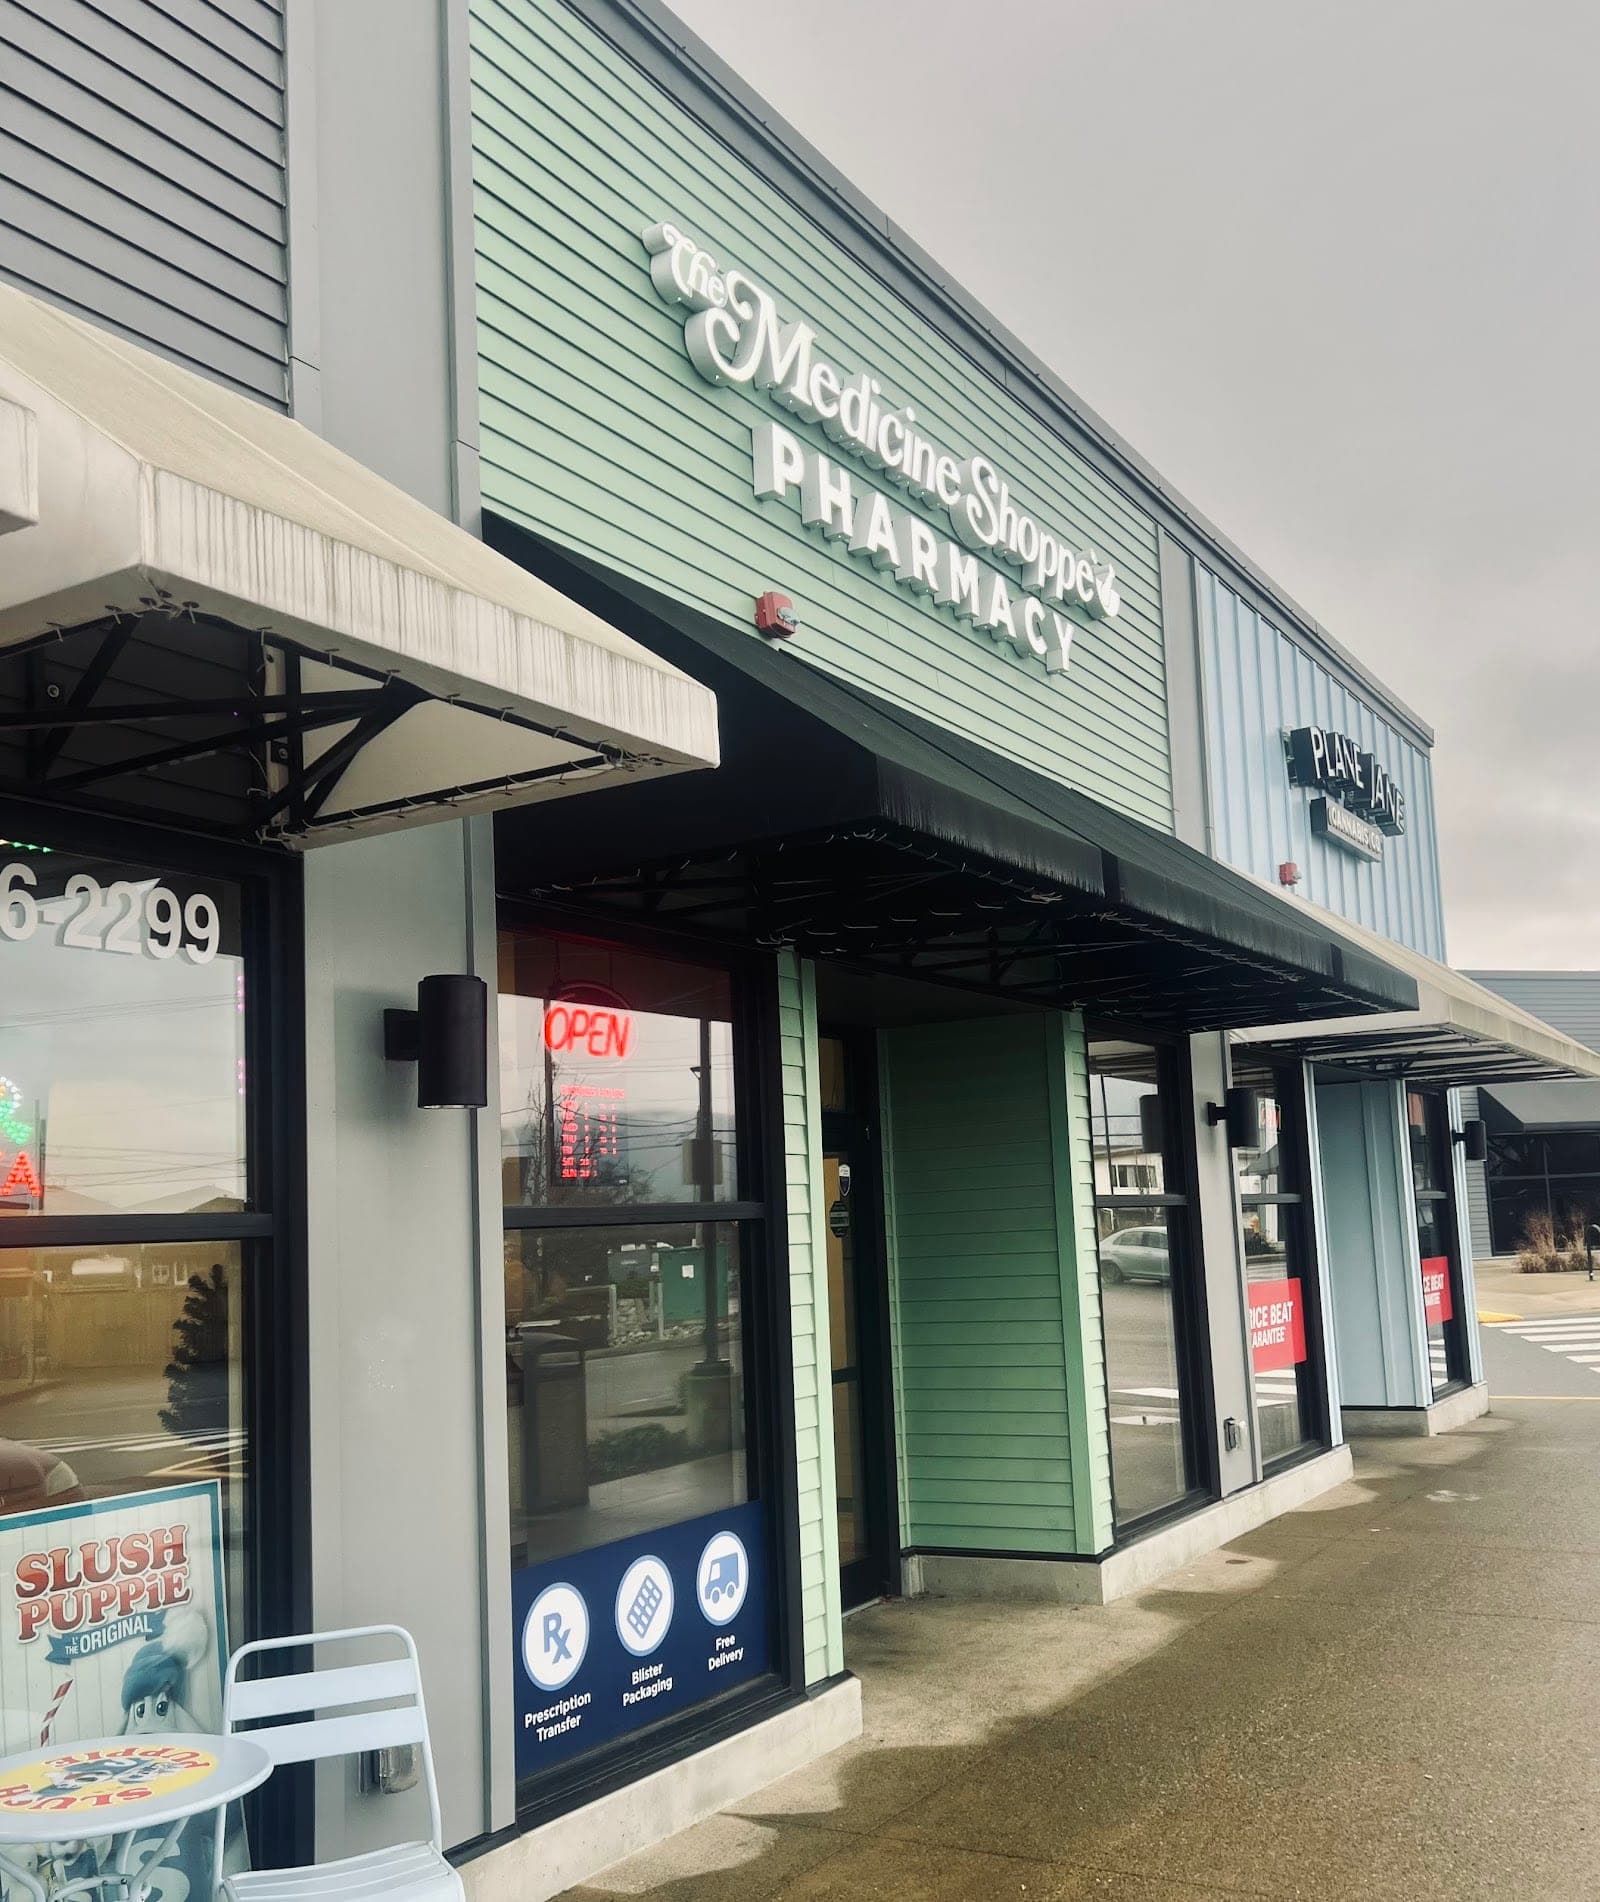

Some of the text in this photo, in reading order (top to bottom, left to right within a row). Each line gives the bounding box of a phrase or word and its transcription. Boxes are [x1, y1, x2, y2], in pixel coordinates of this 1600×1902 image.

[650, 222, 727, 306] The
[696, 269, 1096, 602] Medicine Shoppe
[760, 423, 1075, 673] PHARMACY
[1307, 726, 1364, 789] PLANE
[0, 863, 219, 964] 6-2299
[545, 1007, 630, 1057] OPEN
[1249, 1301, 1293, 1329] RICE BEAT
[1251, 1326, 1286, 1348] ARANTEE
[16, 1524, 187, 1598] SLUSH
[65, 1615, 152, 1655] THE ORIGINAL
[716, 1634, 735, 1652] Free
[631, 1663, 663, 1685] Blister
[708, 1647, 744, 1671] Delivery
[623, 1676, 673, 1707] Packaging
[524, 1692, 591, 1729] Prescription
[536, 1714, 581, 1743] Transfer
[45, 1747, 210, 1769] PUPPIE
